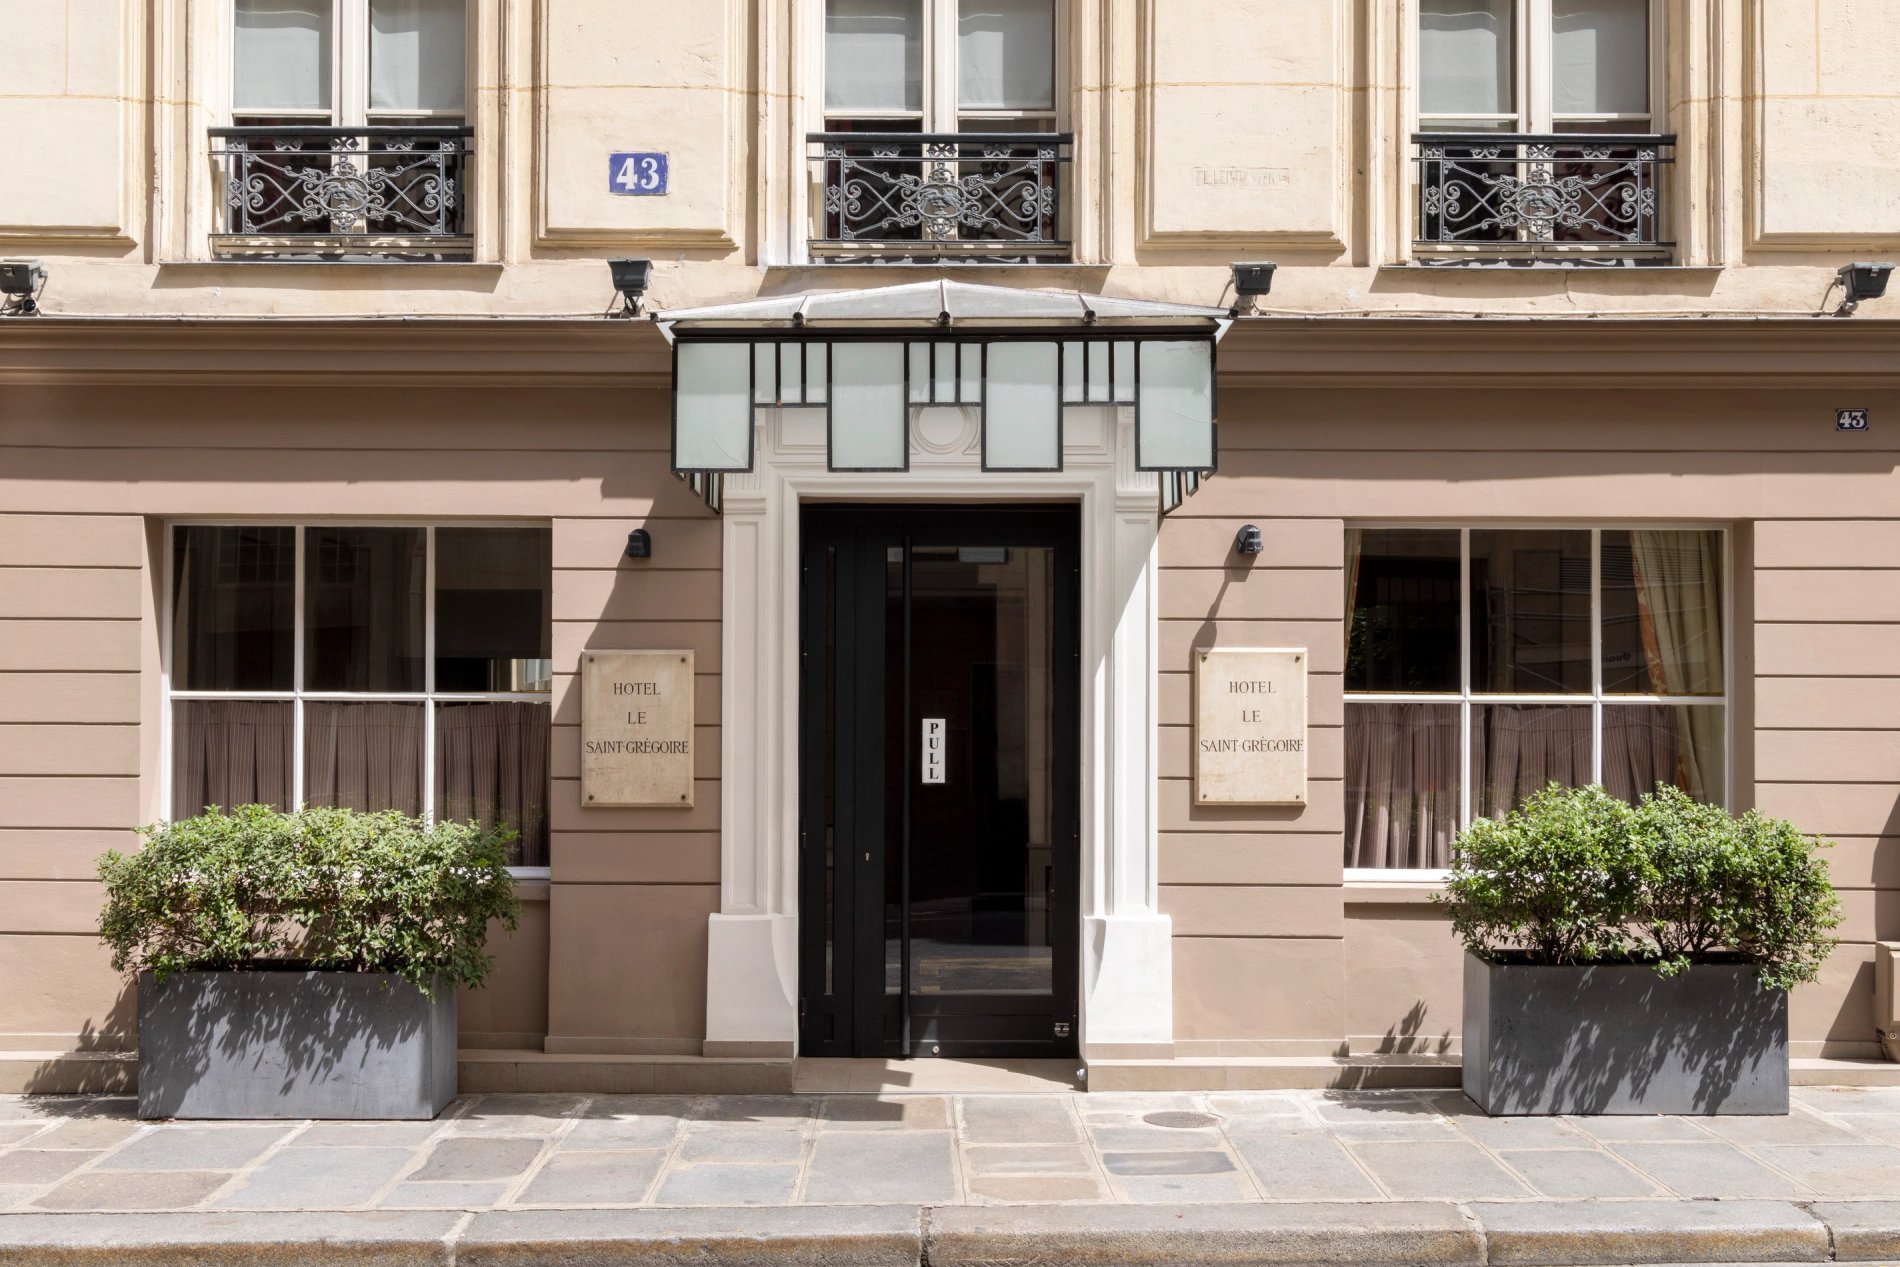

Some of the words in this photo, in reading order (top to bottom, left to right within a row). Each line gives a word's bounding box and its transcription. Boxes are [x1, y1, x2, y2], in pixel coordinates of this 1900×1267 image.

[616, 157, 660, 190] 43
[1839, 411, 1865, 428] 43
[613, 682, 661, 695] HOTEL
[1229, 681, 1277, 694] HOTEL
[627, 711, 647, 725] LE
[1242, 710, 1262, 723] LE
[928, 722, 940, 780] PULL
